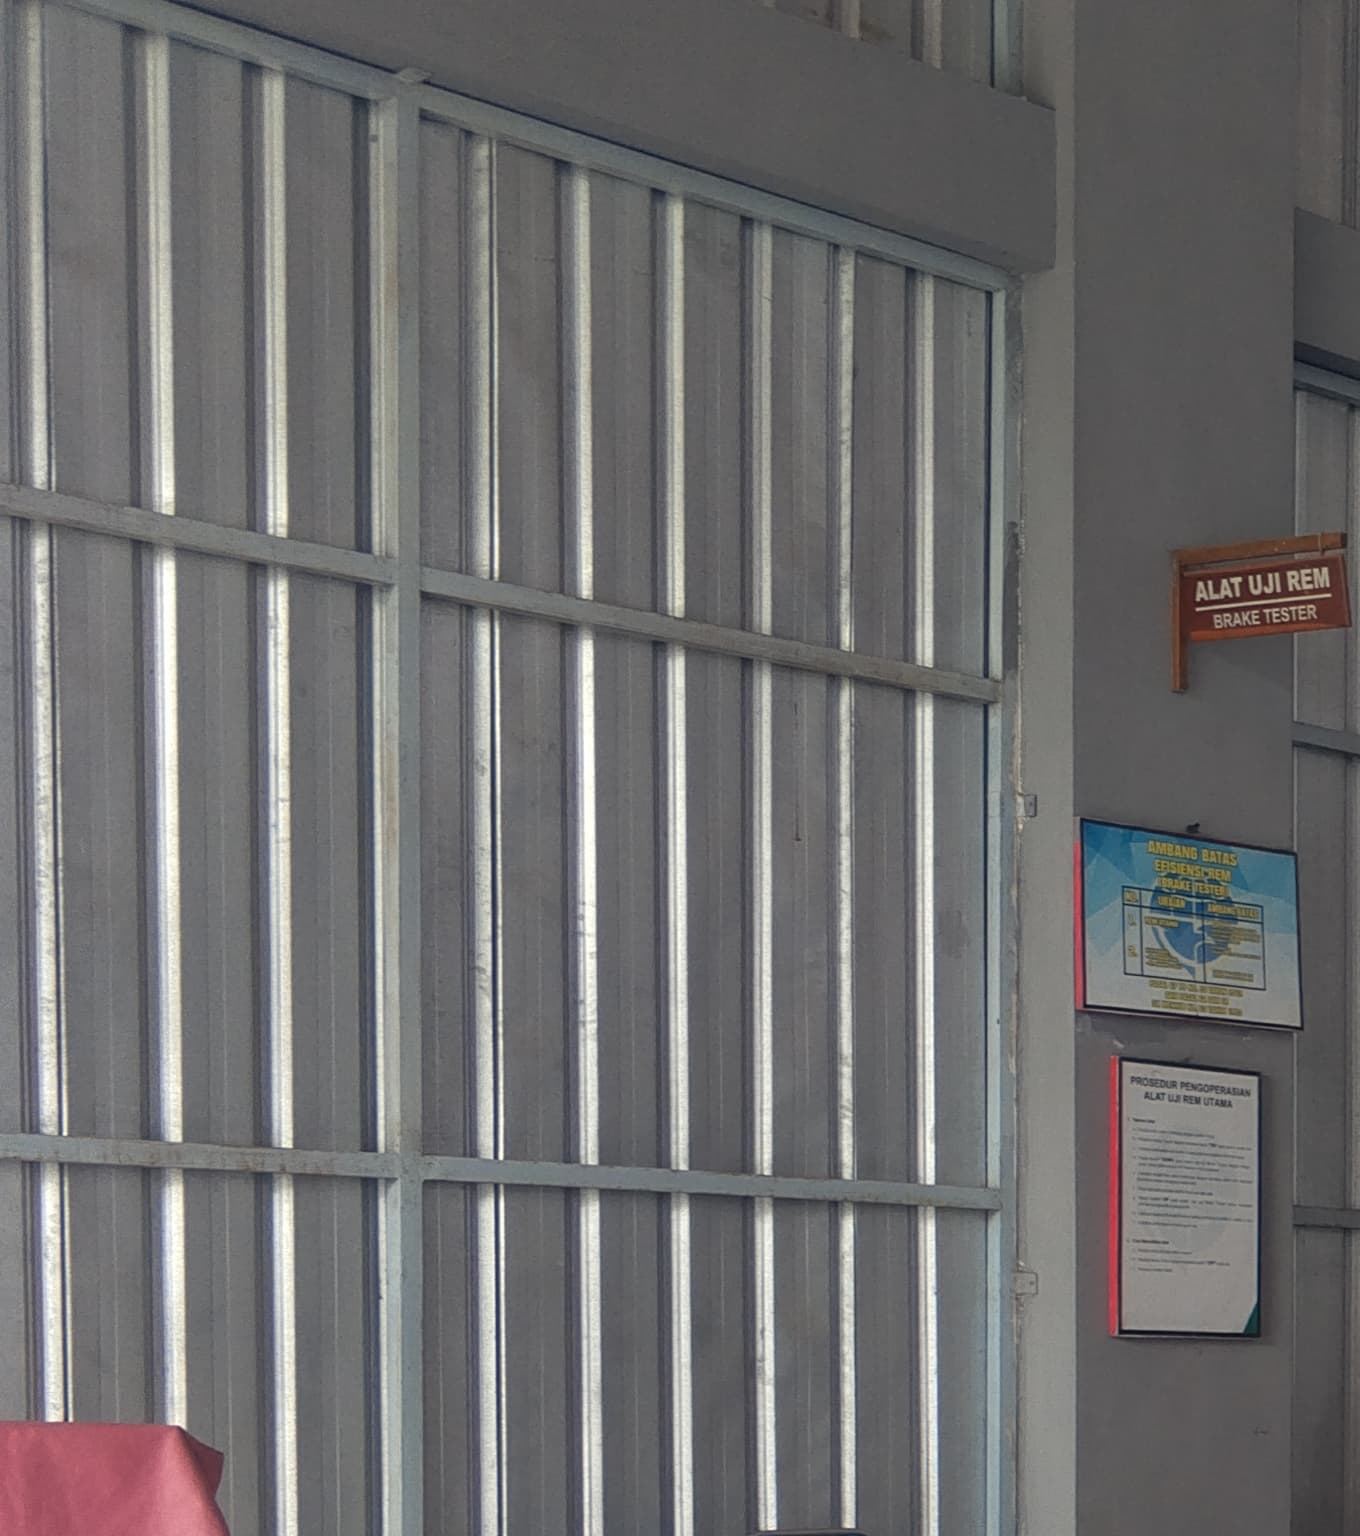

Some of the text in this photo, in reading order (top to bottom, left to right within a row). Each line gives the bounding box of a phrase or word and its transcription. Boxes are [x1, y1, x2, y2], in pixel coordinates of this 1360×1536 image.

[1195, 566, 1331, 602] ALAT UJI REM
[1213, 604, 1317, 629] BRAKE TESTER
[1148, 840, 1238, 867] AMBANG BATAS
[1130, 1076, 1252, 1097] PROSEDUR PENGOPERASIAN
[1144, 1091, 1233, 1108] ALAT UJI REM UTAMA
